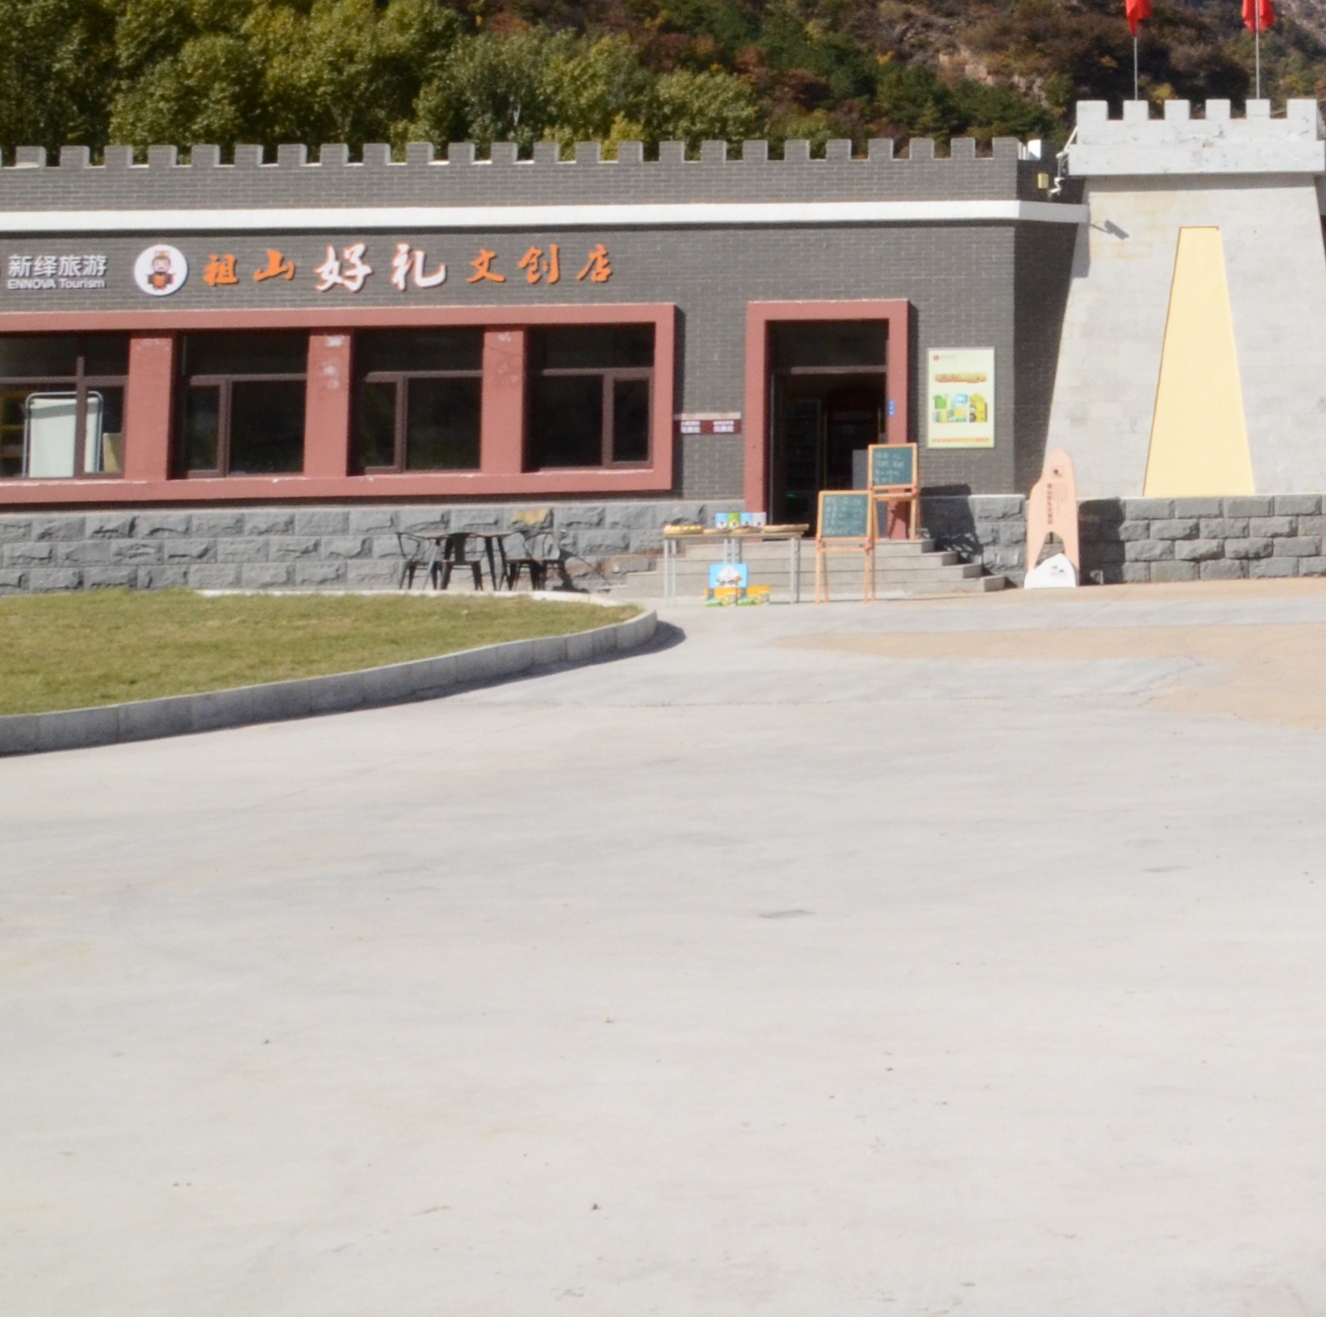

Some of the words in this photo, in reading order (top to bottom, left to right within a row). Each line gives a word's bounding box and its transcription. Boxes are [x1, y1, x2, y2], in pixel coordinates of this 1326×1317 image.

[8, 254, 107, 277] 新绎旅游
[7, 278, 56, 290] ENNOVA
[60, 278, 105, 289] Tourism
